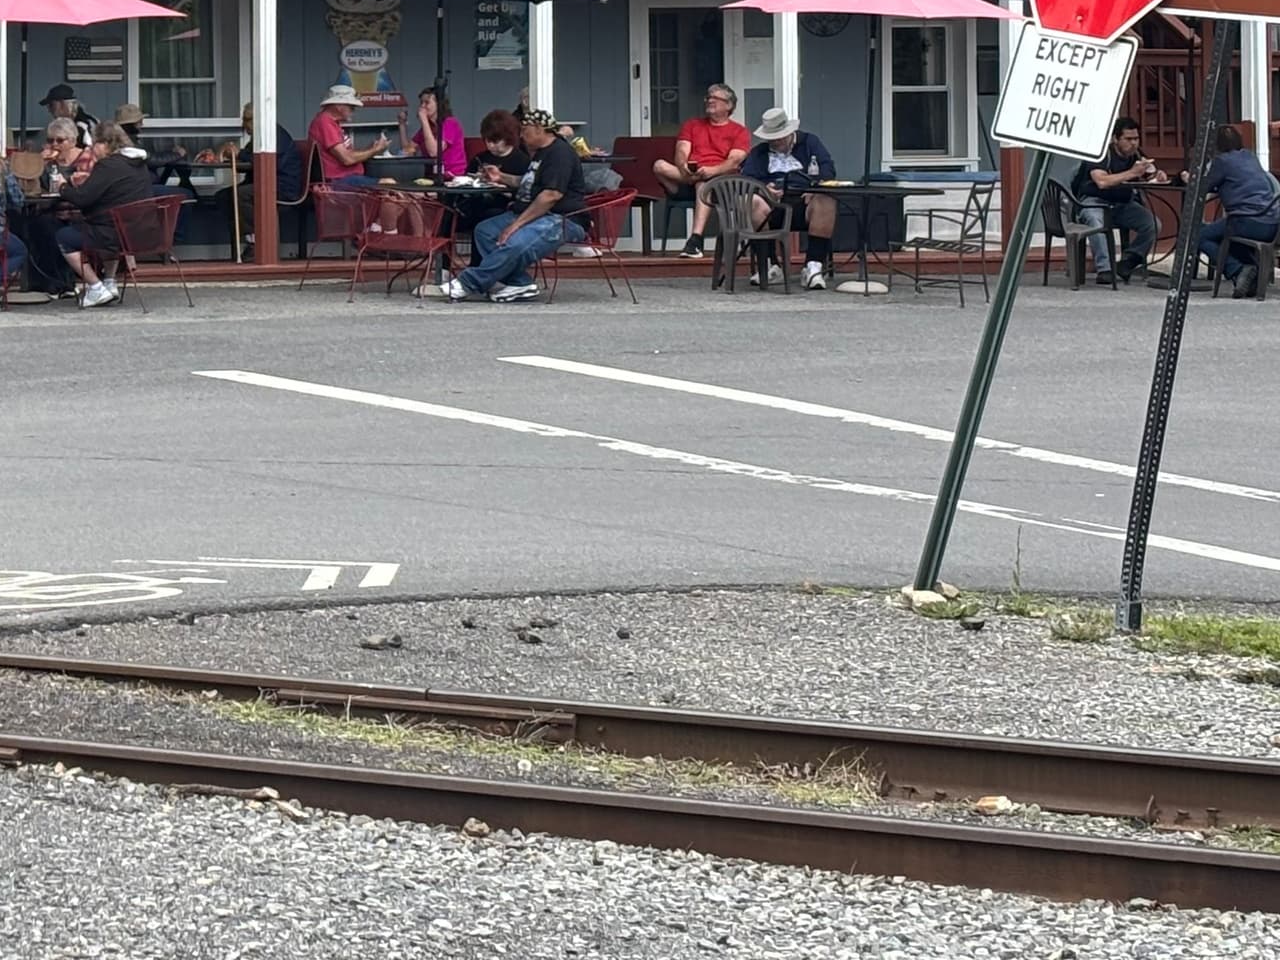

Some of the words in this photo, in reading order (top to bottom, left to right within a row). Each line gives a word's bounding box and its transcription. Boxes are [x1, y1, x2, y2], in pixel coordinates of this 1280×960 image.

[478, 2, 498, 13] Get
[478, 16, 499, 27] and
[478, 30, 504, 41] Ride
[1035, 37, 1108, 72] EXCEPT
[1031, 72, 1091, 105] RIGHT
[1026, 106, 1077, 138] TURN
